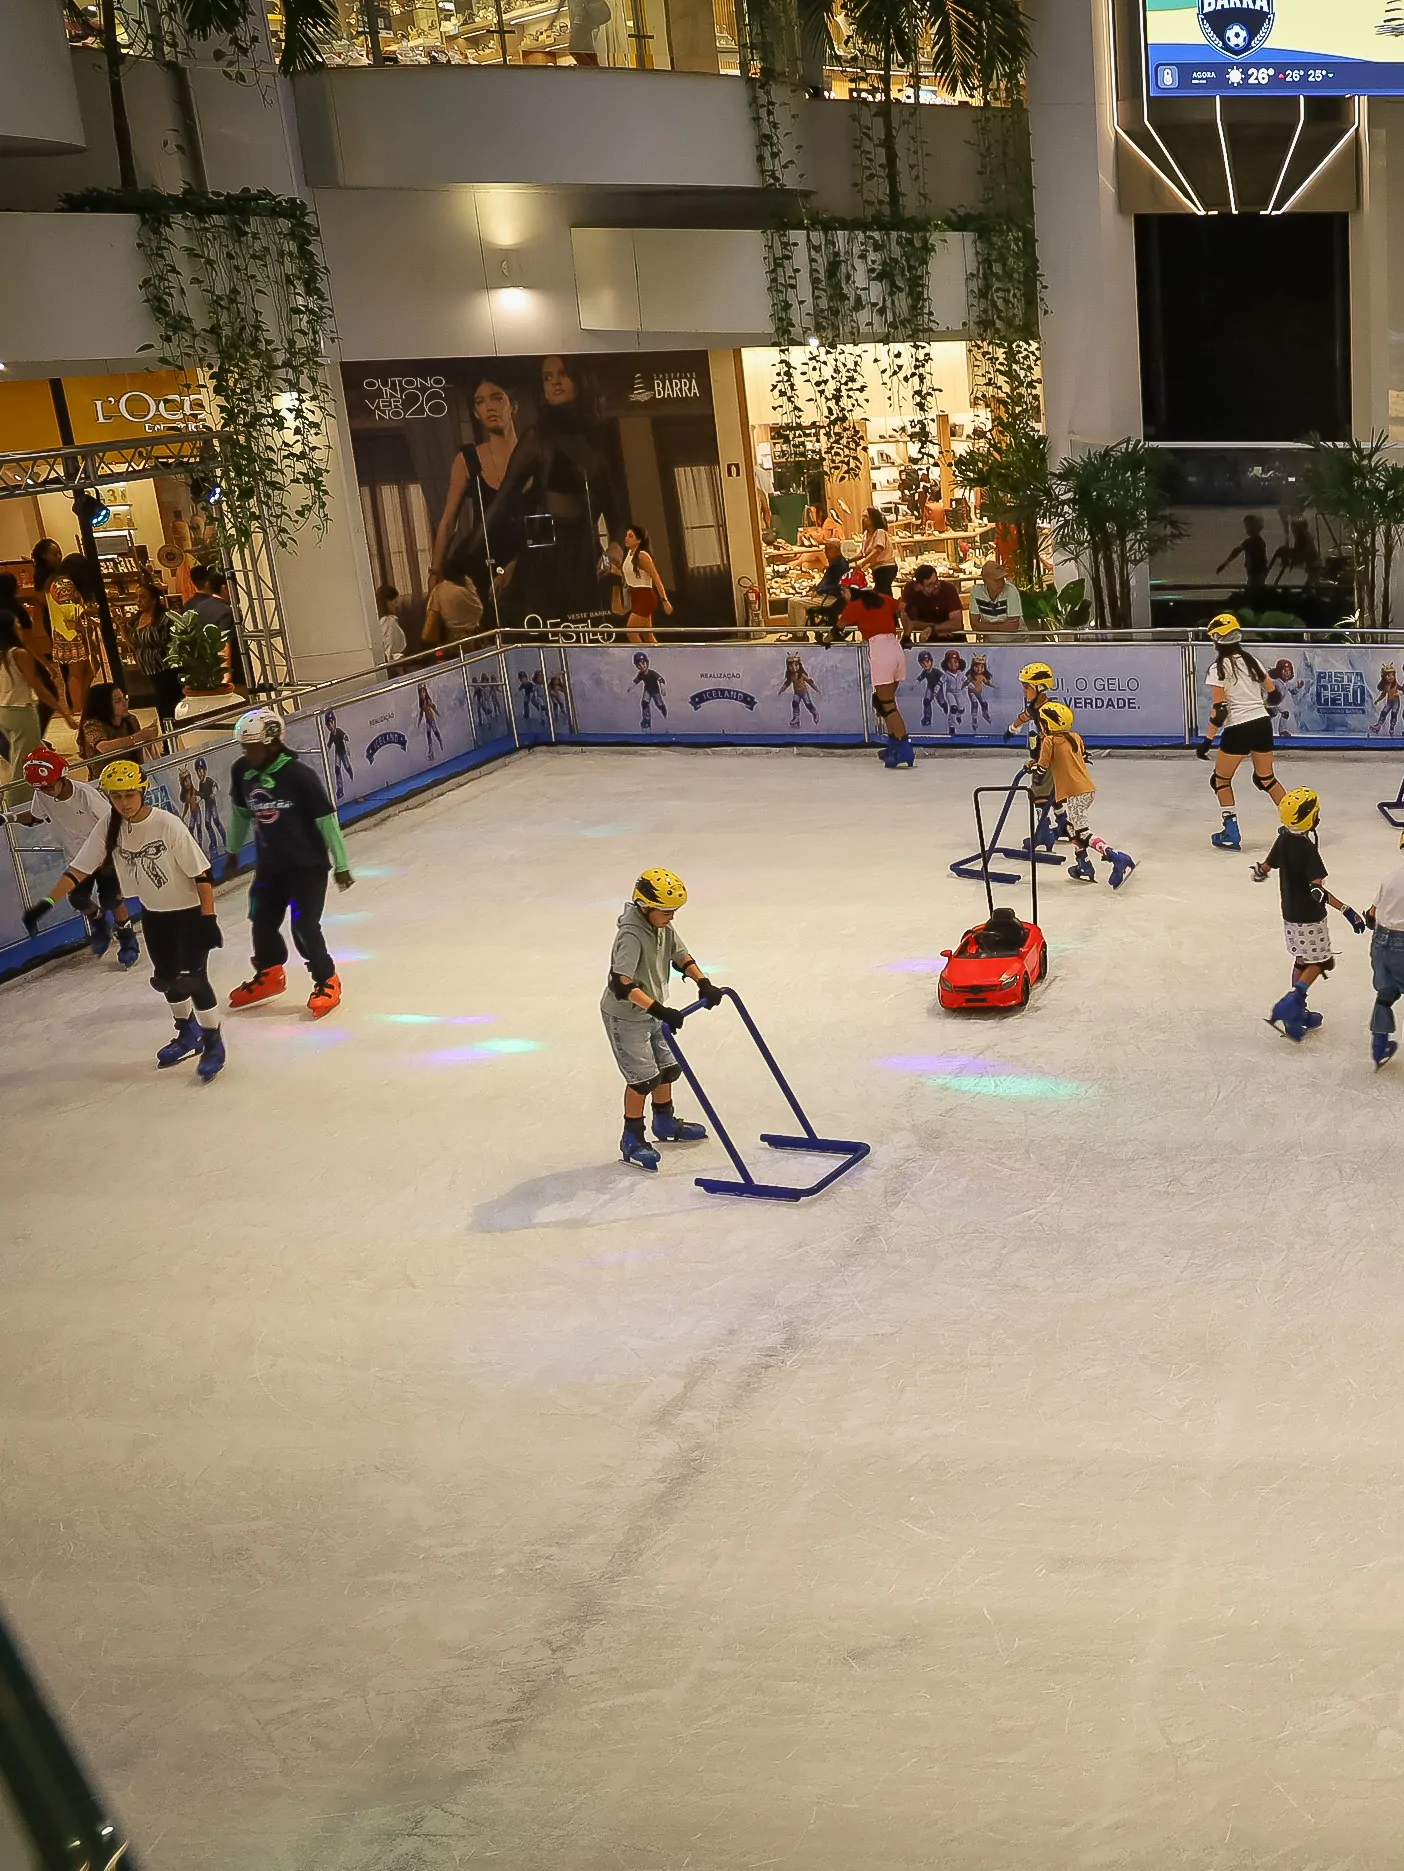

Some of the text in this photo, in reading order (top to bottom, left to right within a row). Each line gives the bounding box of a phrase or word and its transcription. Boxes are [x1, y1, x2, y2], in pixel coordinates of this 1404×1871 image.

[1192, 71, 1216, 79] AGORA
[1247, 67, 1327, 84] 26° 26° 25°
[363, 376, 446, 390] OUTONO
[654, 379, 700, 399] BARRA
[383, 388, 401, 399] IN
[93, 391, 207, 424] L'OCC
[365, 398, 403, 411] VER
[402, 389, 448, 418] 26
[375, 408, 404, 420] NO
[699, 672, 741, 680] REALIZAÇÃO
[1315, 671, 1365, 685] PISTA
[1050, 677, 1140, 693] UI, O GELO
[702, 690, 744, 701] ICELAND
[1063, 697, 1141, 710] VERDADE.
